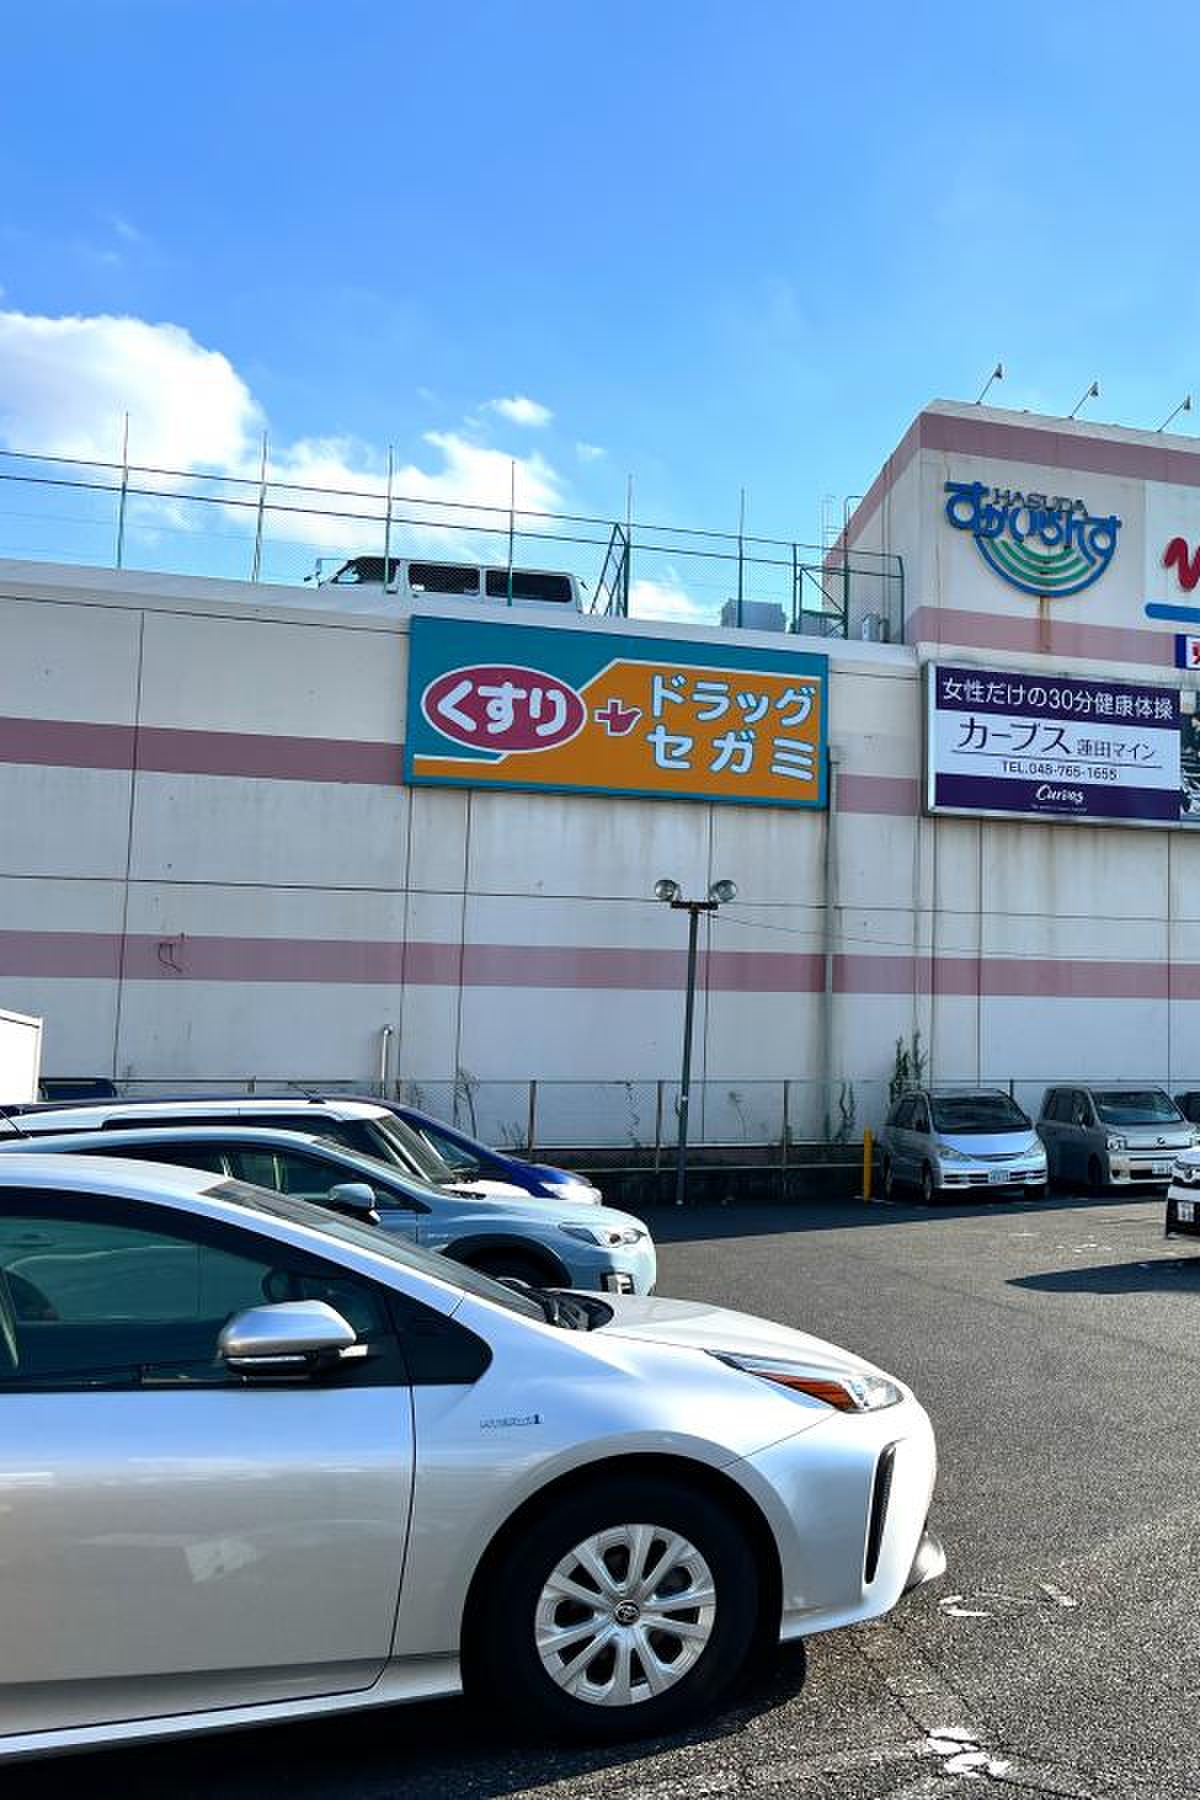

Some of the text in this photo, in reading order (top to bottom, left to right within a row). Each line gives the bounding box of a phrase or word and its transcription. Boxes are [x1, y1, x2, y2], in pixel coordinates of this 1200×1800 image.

[993, 488, 1088, 517] HASUDA
[436, 680, 568, 737] くすり
[652, 674, 815, 727] ドラッグ
[943, 678, 1173, 720] 女性だけの30分健康体操
[647, 724, 815, 782] セガミ
[957, 717, 1156, 761] カーブス 蓮田マイン
